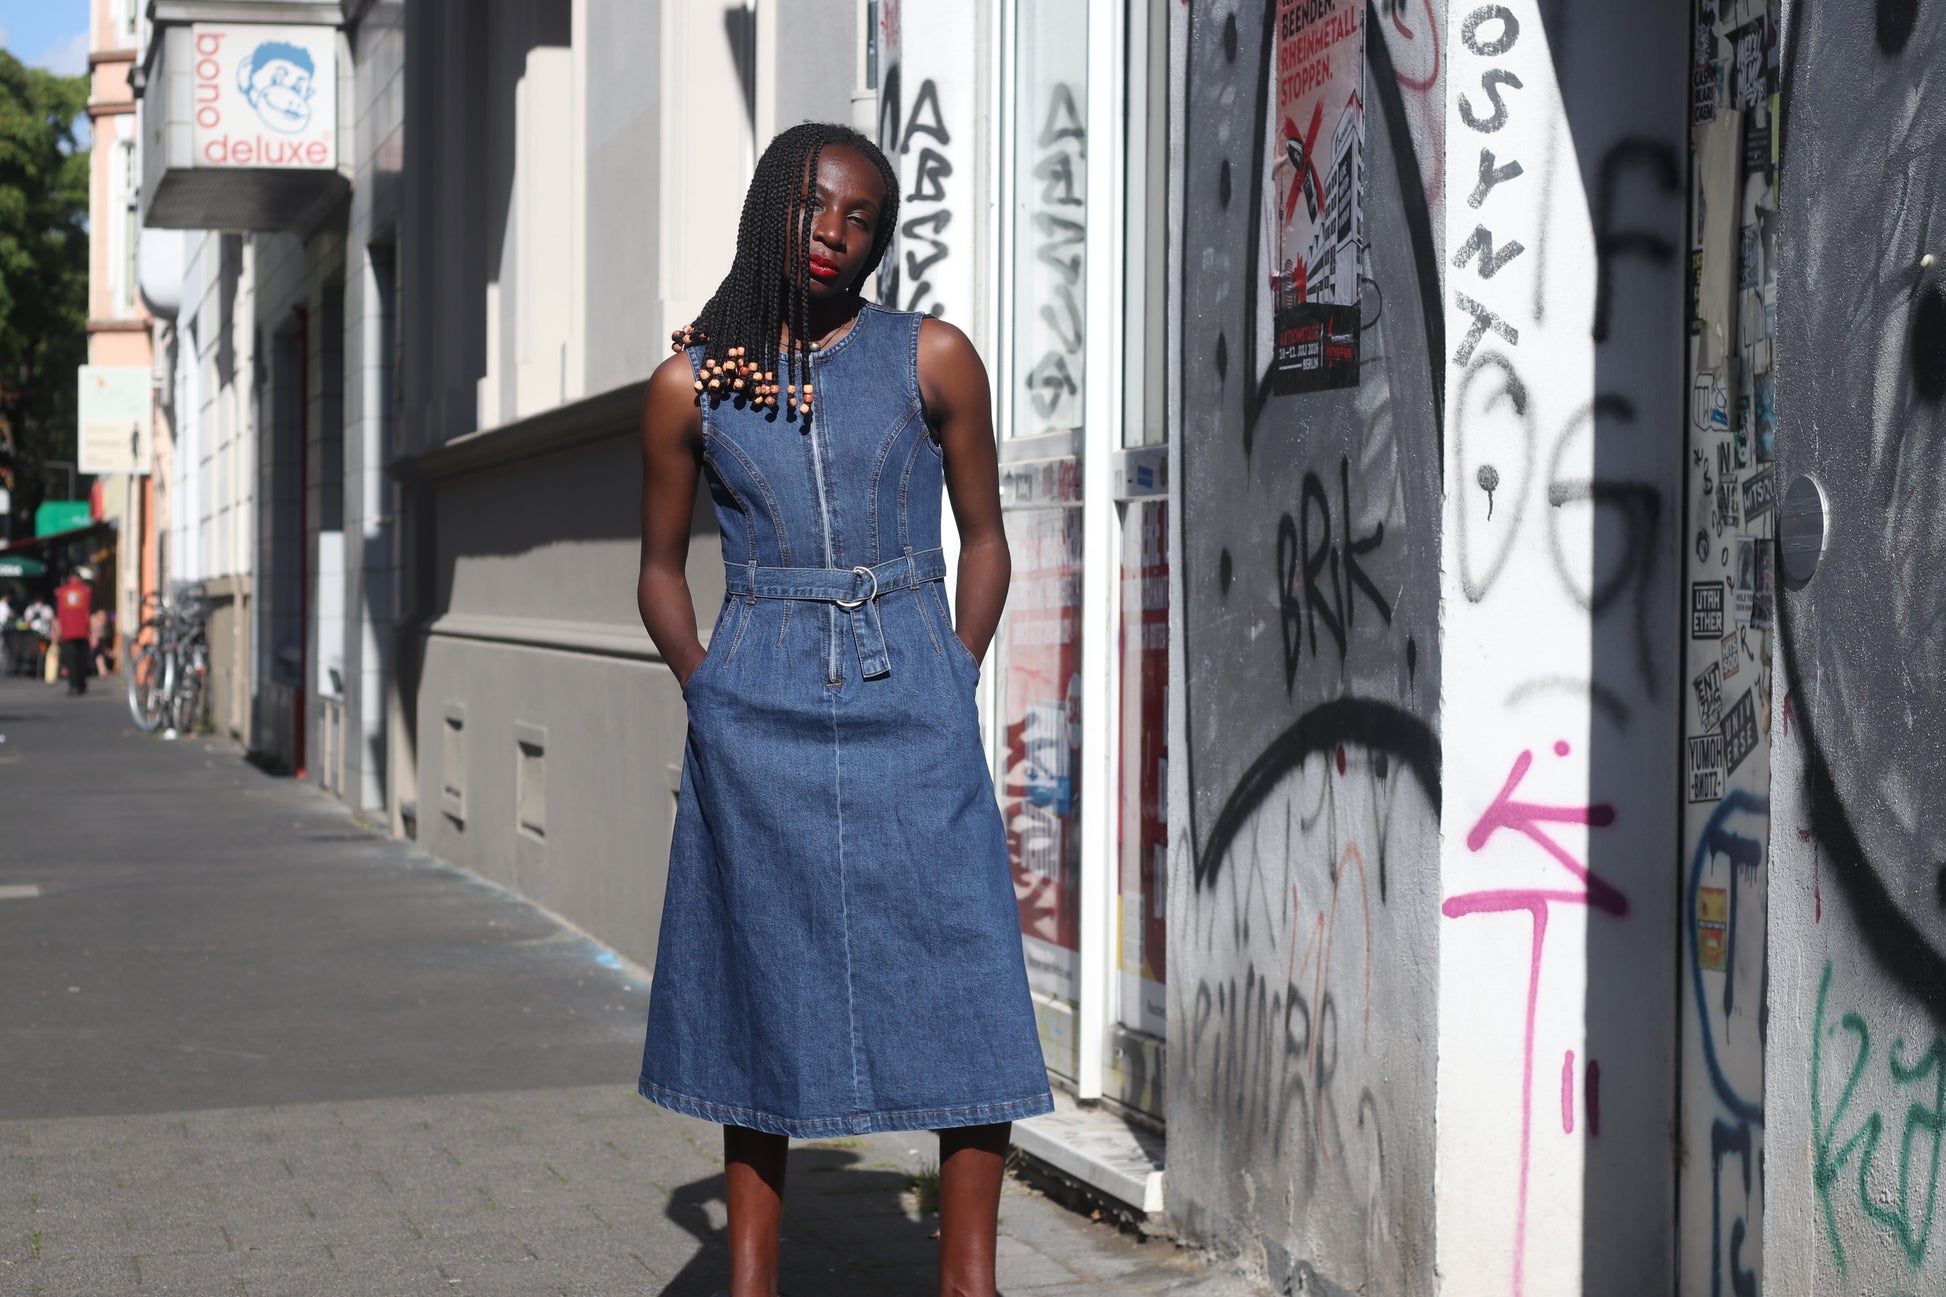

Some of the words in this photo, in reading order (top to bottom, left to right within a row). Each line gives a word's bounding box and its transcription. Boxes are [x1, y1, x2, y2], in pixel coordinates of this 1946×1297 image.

[1281, 6, 1357, 73] RHEINMETALL
[1281, 54, 1333, 106] STOPPEN.
[205, 135, 327, 164] deluxe
[1696, 590, 1720, 610] UTAH
[1693, 611, 1722, 632] ETHER
[1726, 695, 1751, 741] UNIV
[1690, 738, 1722, 771] YUMOH
[1727, 722, 1752, 768] ERSE
